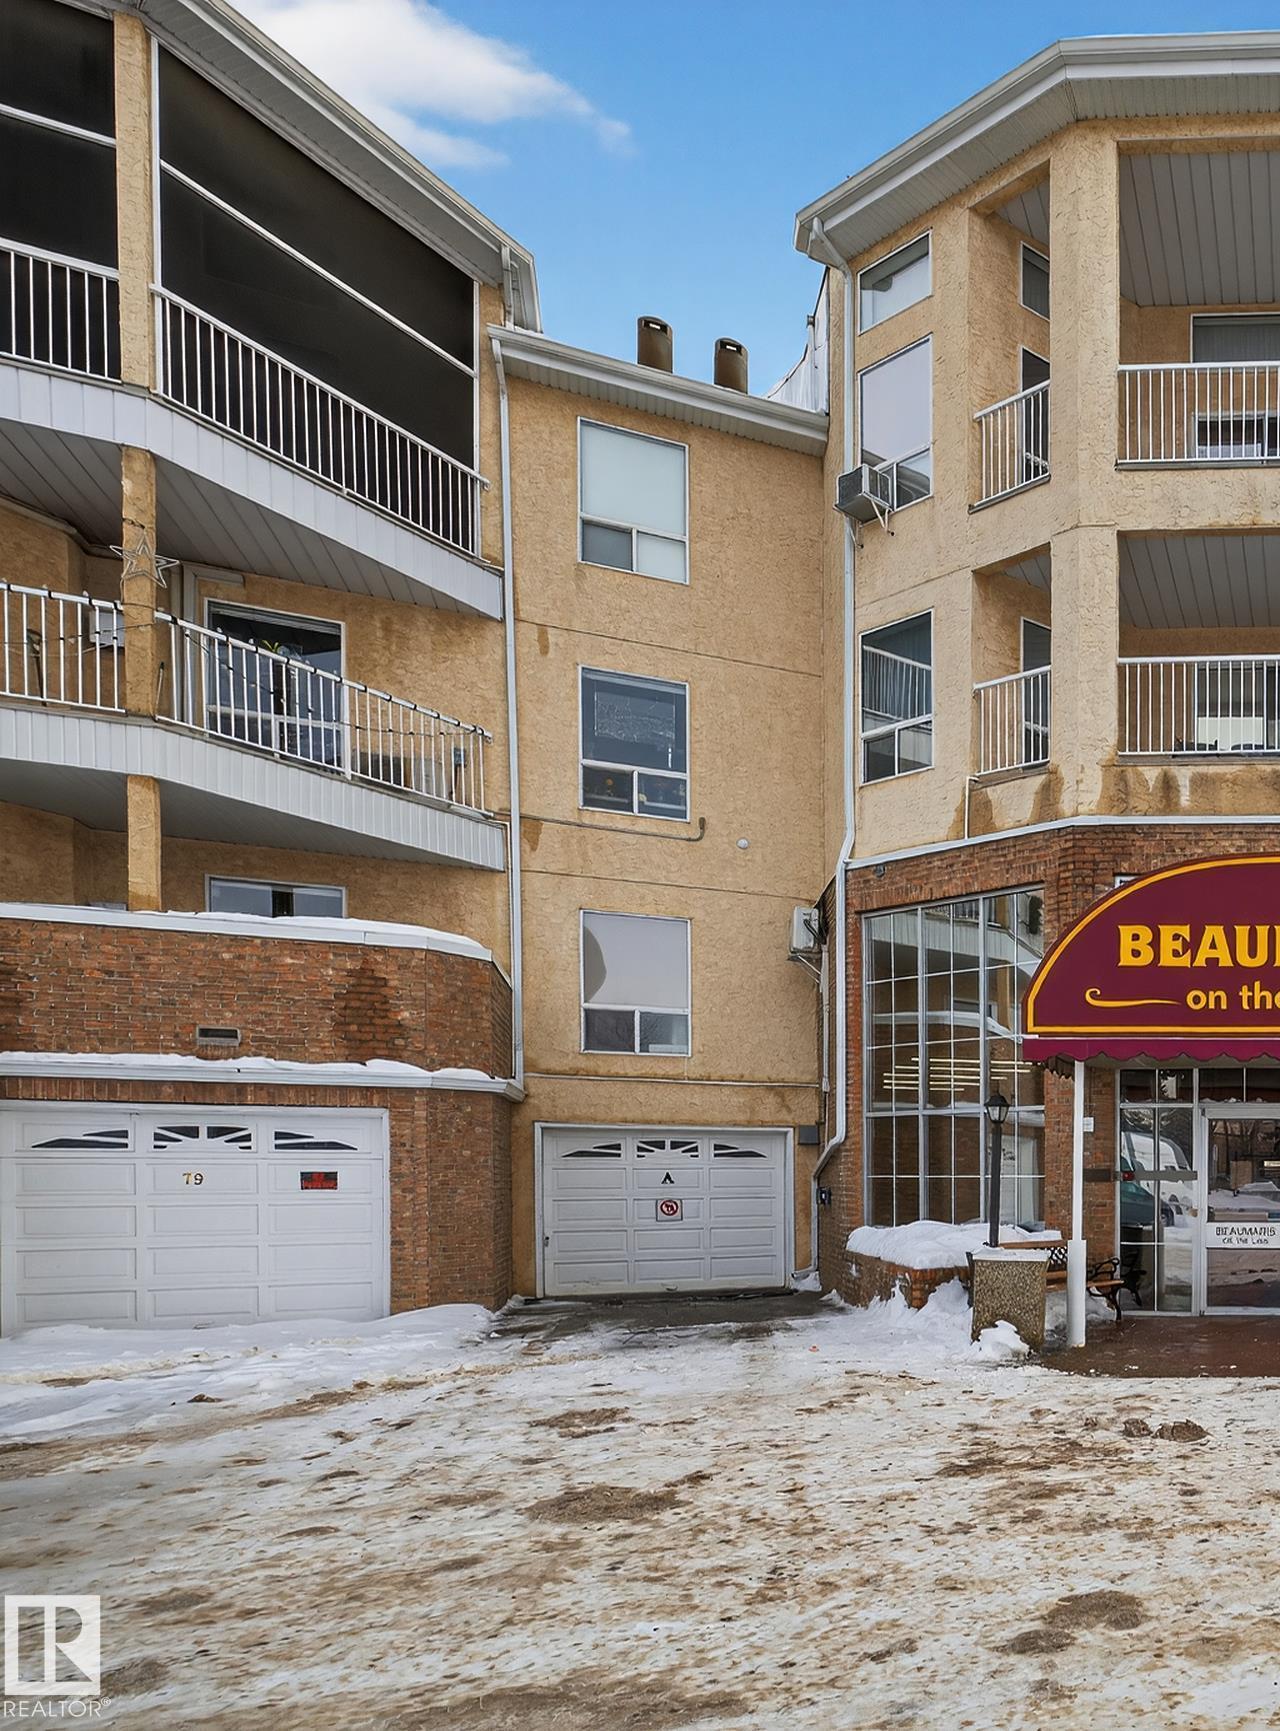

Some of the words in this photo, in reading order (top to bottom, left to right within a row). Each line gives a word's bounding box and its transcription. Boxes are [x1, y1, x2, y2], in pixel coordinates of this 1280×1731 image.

[1186, 990, 1227, 1010] on
[182, 1172, 204, 1186] 79
[661, 1171, 675, 1185] A
